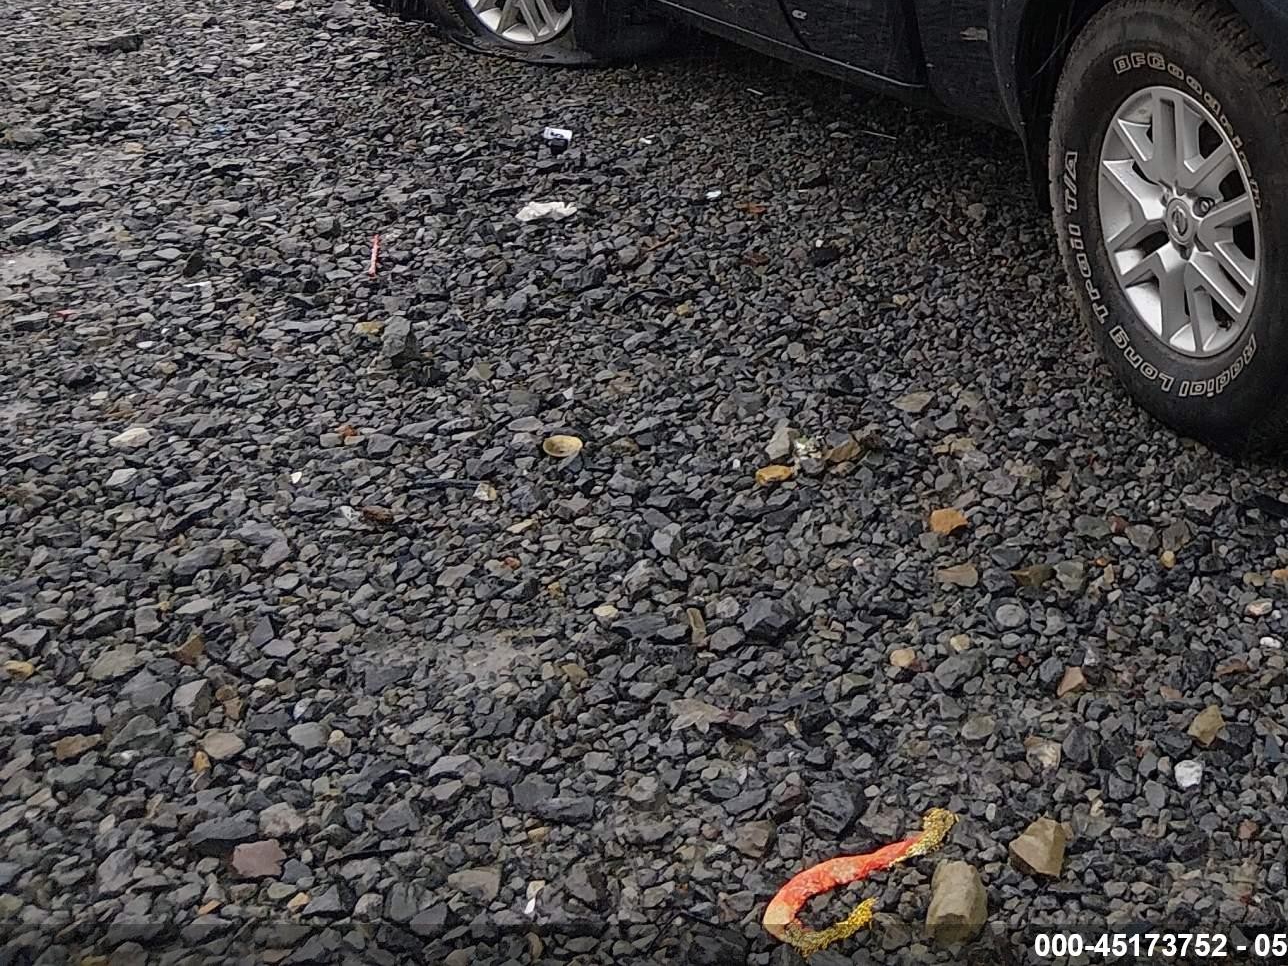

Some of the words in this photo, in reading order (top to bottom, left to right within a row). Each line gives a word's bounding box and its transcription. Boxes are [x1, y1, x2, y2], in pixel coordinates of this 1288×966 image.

[1064, 151, 1079, 216] T/A
[1067, 223, 1110, 325] Trail
[1108, 325, 1174, 392] Long
